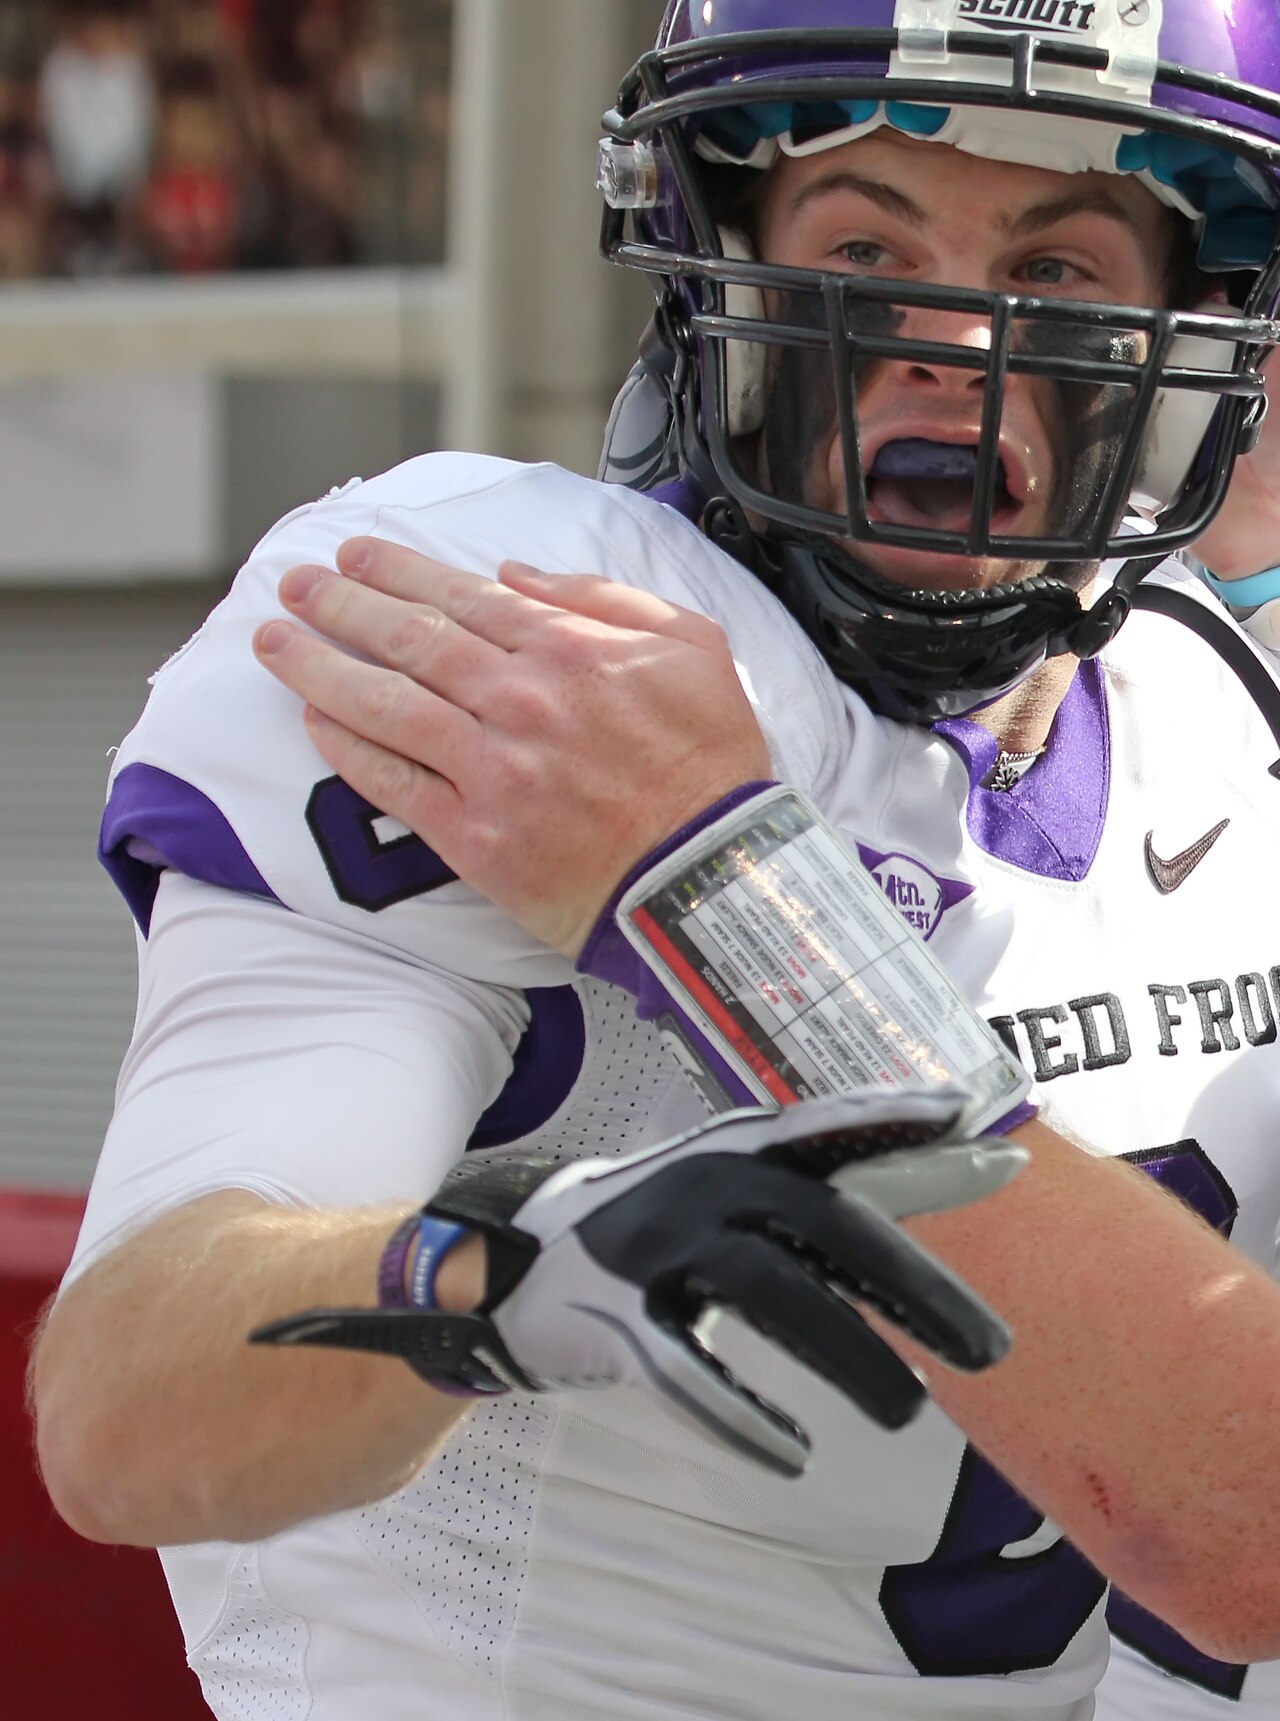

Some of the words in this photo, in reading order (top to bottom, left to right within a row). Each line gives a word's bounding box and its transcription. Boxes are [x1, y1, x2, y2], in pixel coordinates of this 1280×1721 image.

[710, 920, 731, 945] SEAM
[902, 911, 930, 930] EST
[734, 920, 759, 950] SMACK
[760, 923, 780, 946] READ
[733, 948, 753, 972] NUDE
[756, 947, 777, 971] NUDE
[776, 944, 788, 956] 13
[717, 960, 743, 989] FREEZE
[749, 969, 761, 982] 13
[785, 954, 807, 980] MOVE
[699, 963, 729, 998] HANDS
[804, 1036, 824, 1059] SEAM
[987, 991, 1132, 1083] ED
[826, 1063, 846, 1087] NUDE
